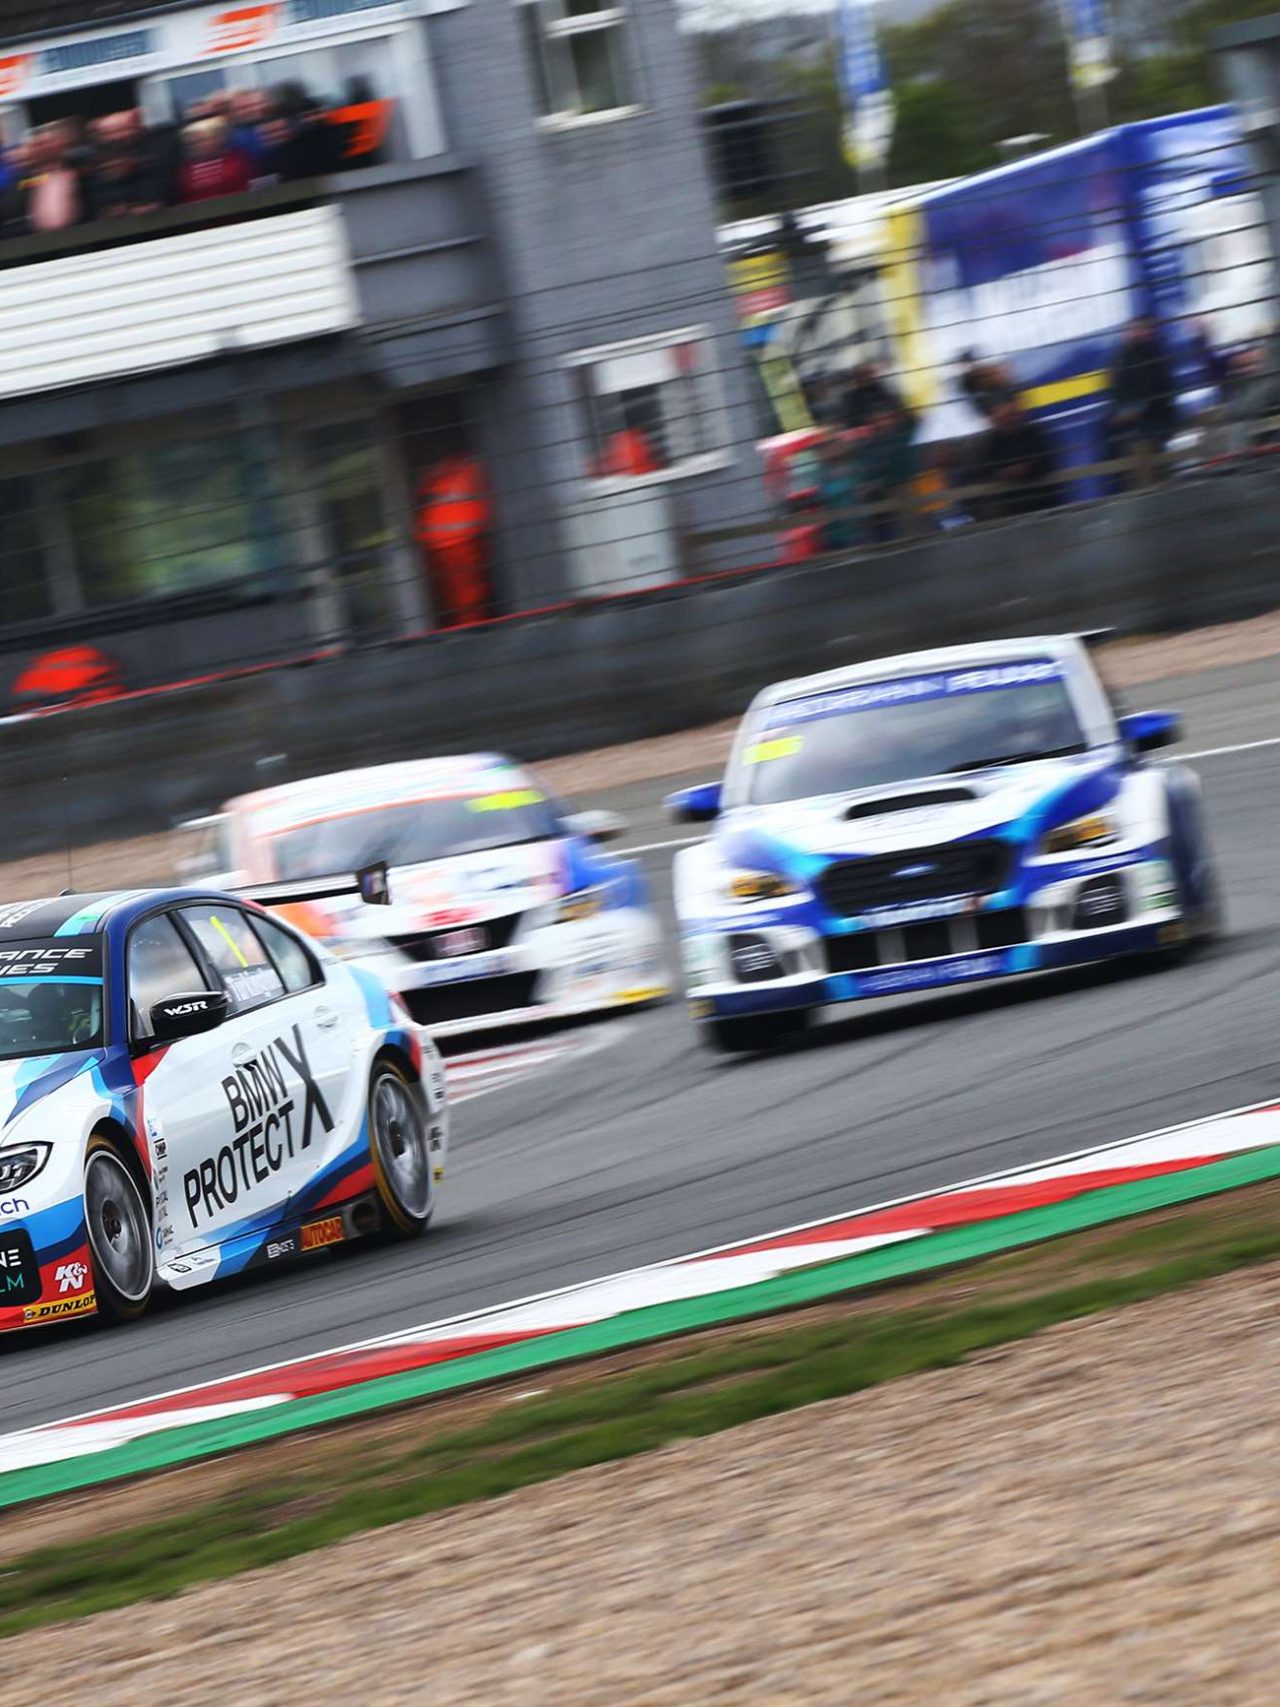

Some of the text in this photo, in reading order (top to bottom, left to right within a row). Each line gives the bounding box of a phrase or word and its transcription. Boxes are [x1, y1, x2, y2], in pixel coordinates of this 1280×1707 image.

[221, 1044, 289, 1134] BMW
[273, 1023, 335, 1150] X
[184, 1099, 295, 1229] PROTECT
[38, 1294, 97, 1317] DUNLOP
